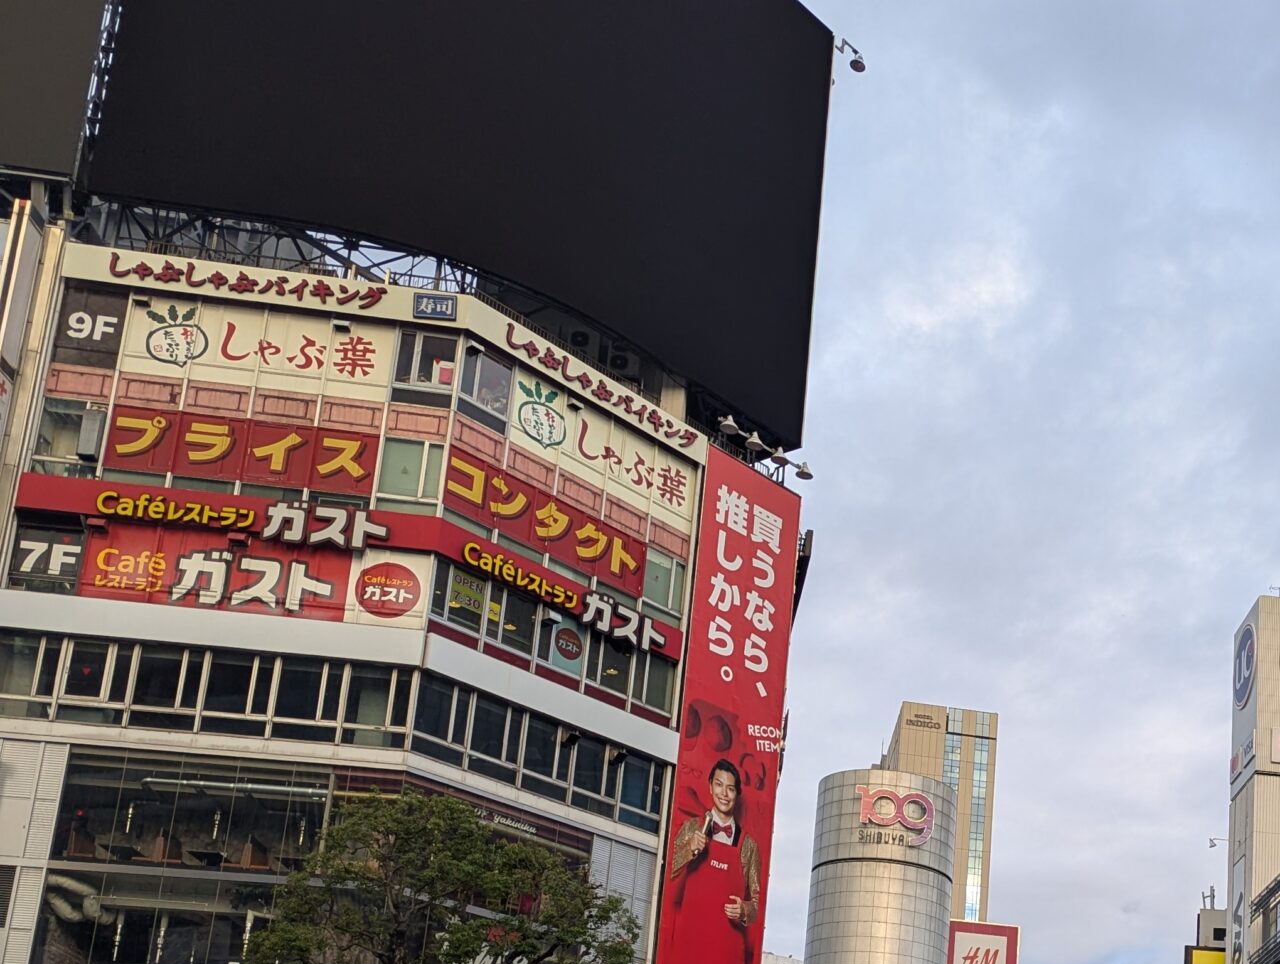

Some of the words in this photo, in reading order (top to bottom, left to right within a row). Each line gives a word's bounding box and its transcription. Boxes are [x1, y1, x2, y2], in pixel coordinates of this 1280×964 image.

[109, 252, 388, 309] しゃぶしゃぶバイキング
[66, 310, 118, 342] 9F
[219, 321, 377, 378] しゃぶ葉
[505, 322, 699, 449] しゃぶしゃぶバイキング
[114, 416, 369, 479] プライス
[578, 419, 689, 508] しゃぶ葉
[261, 501, 390, 549] ガスト
[447, 456, 641, 576] コンタクト
[18, 540, 82, 576] 7F
[95, 574, 163, 593] レストラン
[96, 548, 167, 574] Café
[168, 549, 334, 612] ガスト
[455, 573, 484, 594] OPEN
[363, 585, 414, 602] ガスト
[559, 640, 580, 654] ガスト
[582, 590, 667, 653] ガスト
[856, 784, 936, 846] 109
[858, 829, 905, 847] SHIBUYA
